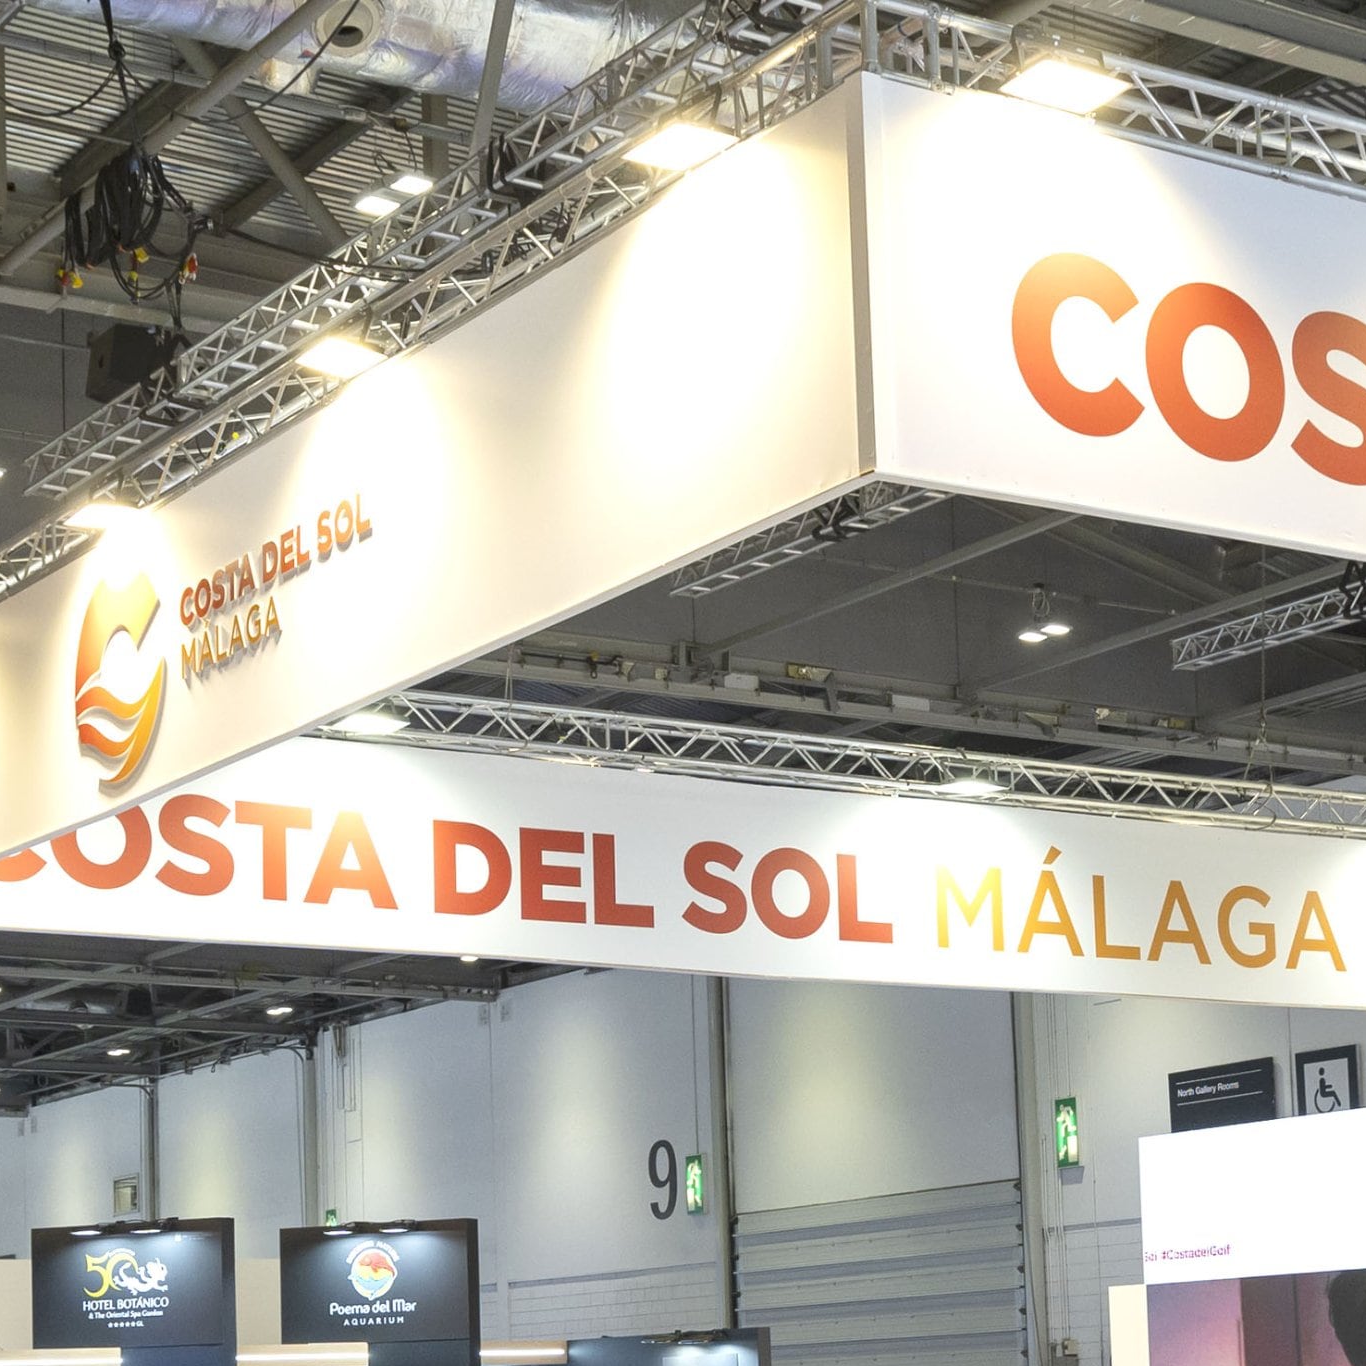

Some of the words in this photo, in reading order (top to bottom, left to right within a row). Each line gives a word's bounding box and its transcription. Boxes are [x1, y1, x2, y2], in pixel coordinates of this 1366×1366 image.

[180, 553, 258, 626] COSTA
[262, 525, 310, 584] DEL
[317, 493, 371, 554] SOL
[434, 820, 656, 928] DEL
[682, 838, 894, 944] SOL
[936, 845, 1348, 972] MÁLAGA
[1177, 1088, 1195, 1097] North
[1195, 1085, 1216, 1094] Gallery
[1217, 1082, 1239, 1091] Rooms
[648, 1139, 678, 1220] 9
[82, 1299, 115, 1311] HOTEL
[117, 1296, 170, 1310] BOTÁNICO
[329, 1302, 371, 1315] Poema
[371, 1299, 391, 1313] del
[392, 1298, 417, 1312] Mar
[106, 1310, 130, 1319] Oriental
[130, 1311, 141, 1319] Spa
[142, 1309, 164, 1317] Garden
[343, 1316, 404, 1327] AQUARIUM
